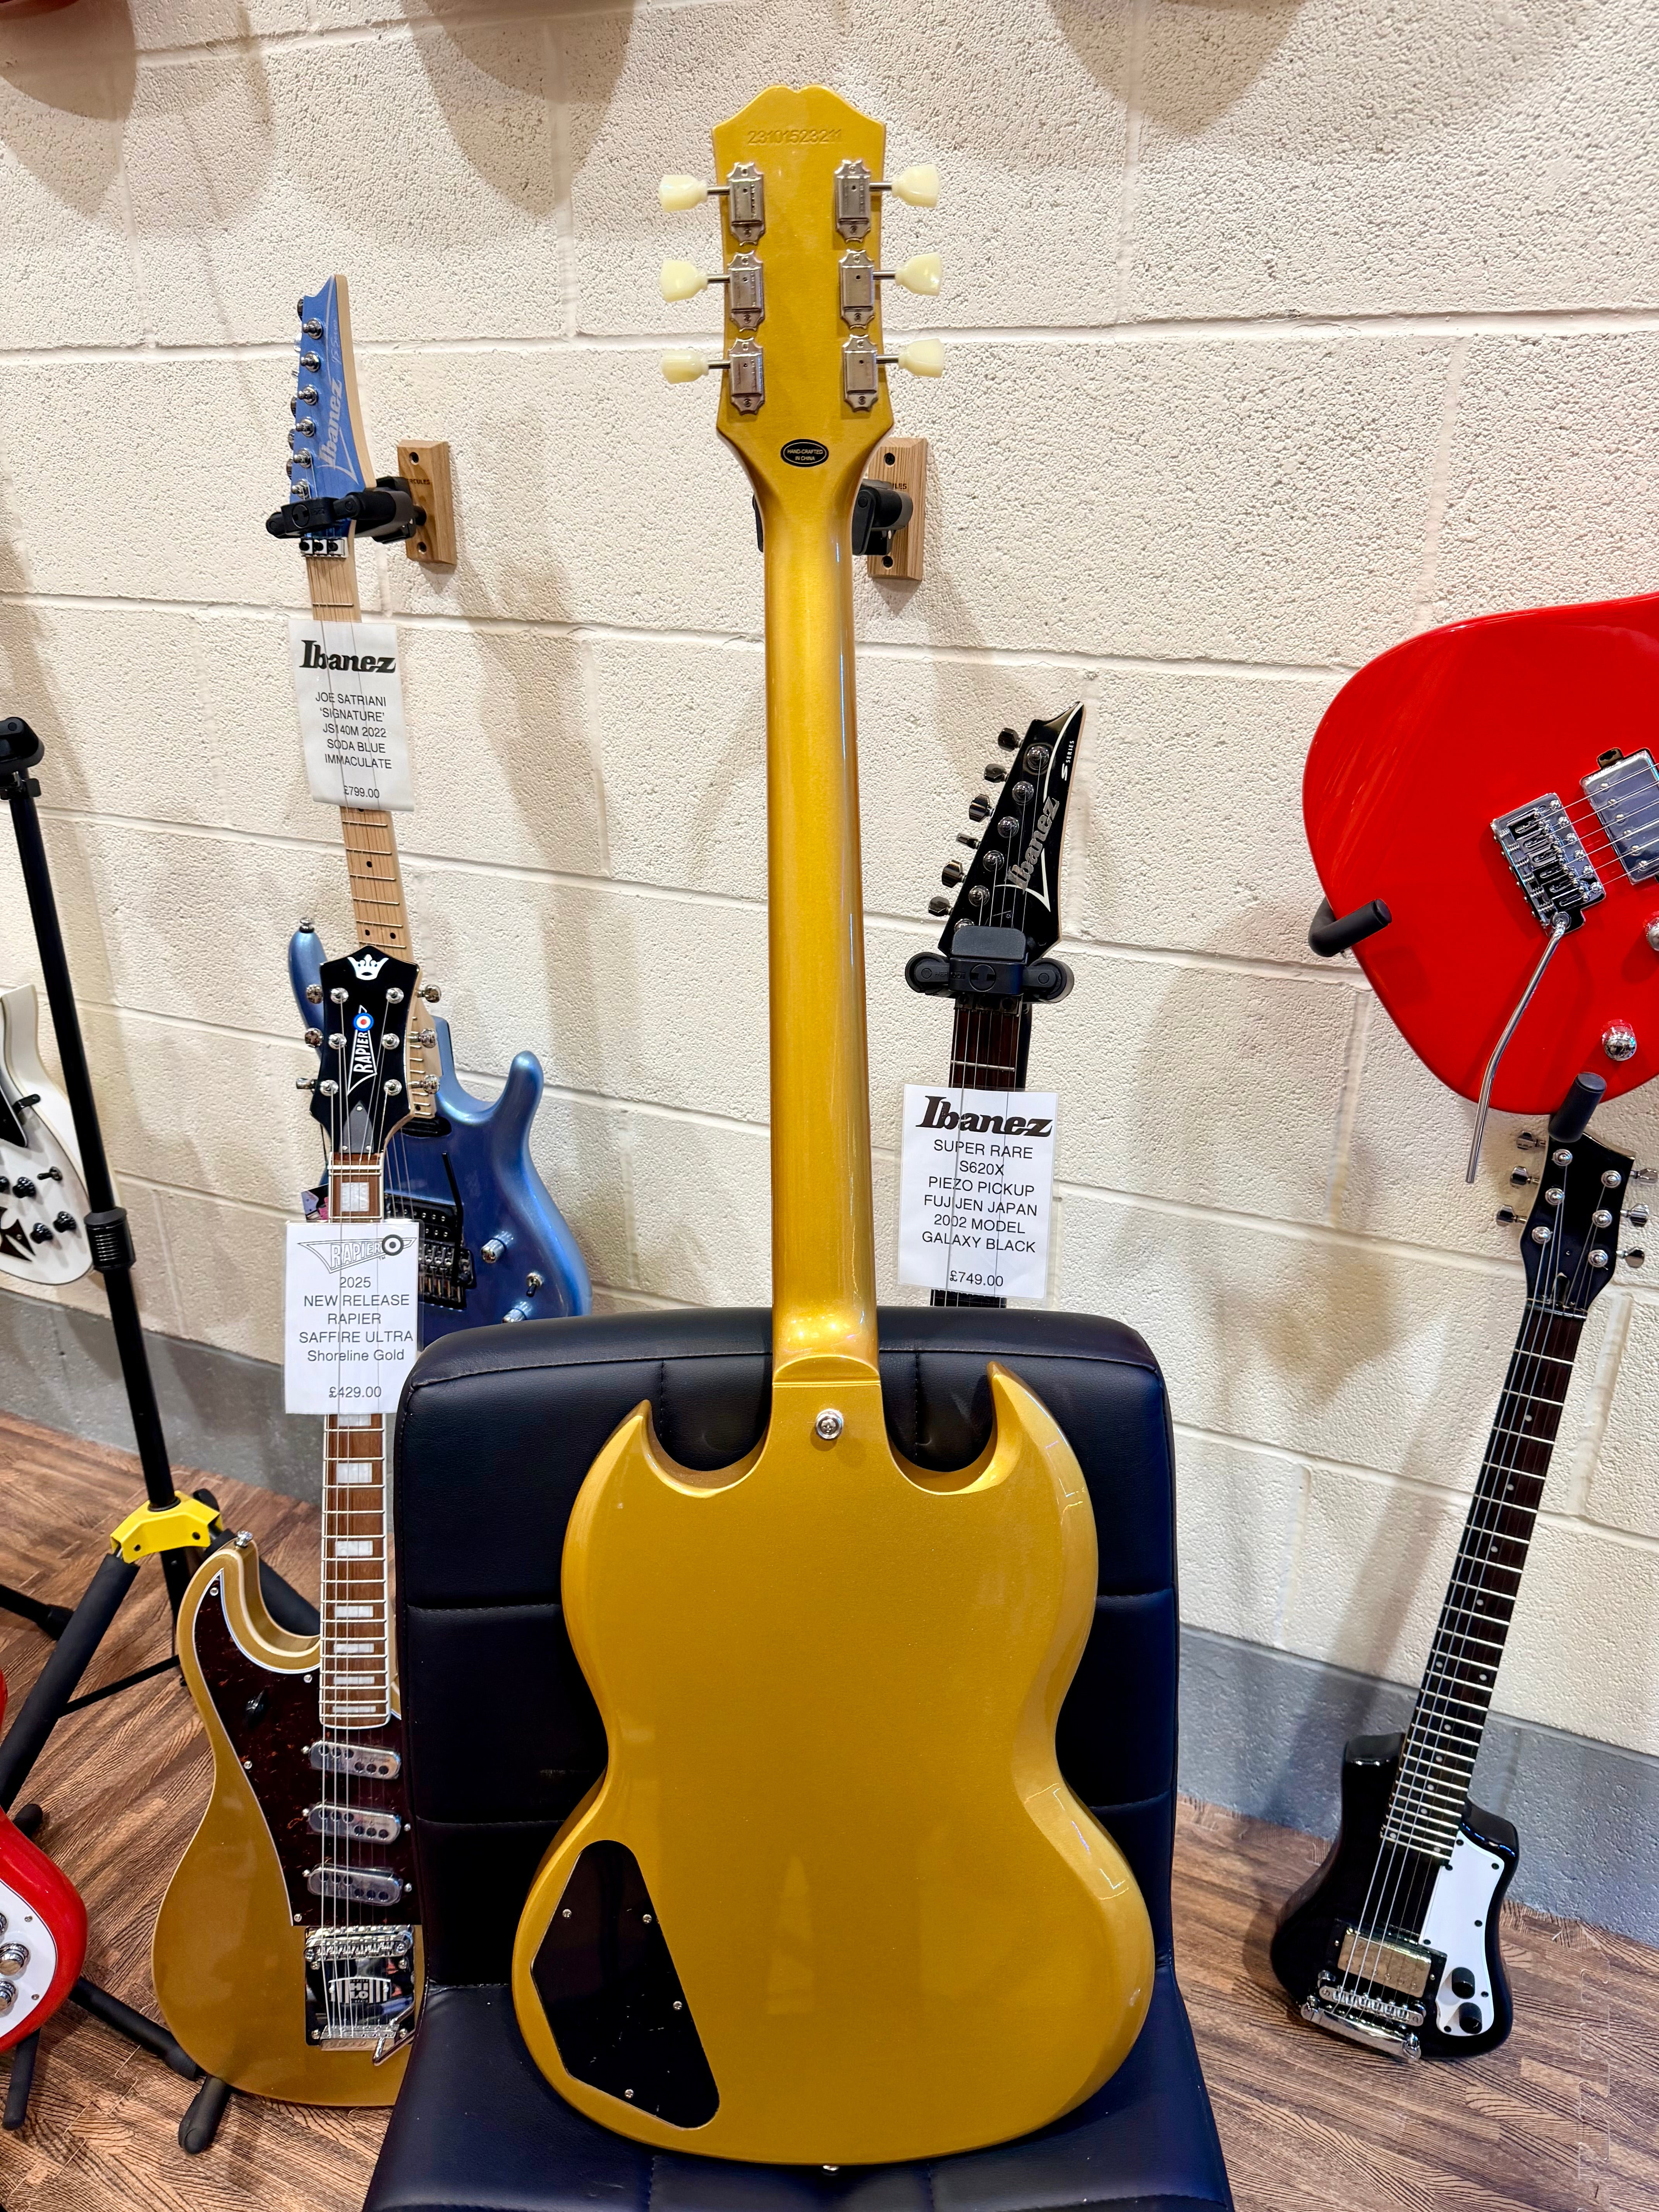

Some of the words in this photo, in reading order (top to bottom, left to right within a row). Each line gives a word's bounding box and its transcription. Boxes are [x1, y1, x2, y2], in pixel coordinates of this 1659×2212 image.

[318, 380, 343, 470] Ibanez
[299, 640, 396, 673] Ibanez
[315, 692, 335, 703] JOE
[338, 694, 386, 706] SATRIANI
[362, 727, 386, 737] 2022
[327, 739, 355, 750] SODA
[357, 742, 386, 753] BLUE
[1066, 740, 1075, 763] SERIES
[325, 754, 392, 769] IMMACULATE
[344, 785, 380, 798] £799.00
[1005, 796, 1060, 895] Ibanez
[353, 1032, 373, 1073] RAPIER
[915, 1096, 1053, 1137] Ibanez
[934, 1139, 984, 1155] SUPER
[991, 1145, 1033, 1159] RARE
[960, 1160, 1004, 1176] S620X
[929, 1176, 973, 1191] PIEZO
[978, 1182, 1034, 1197] PICKUP
[988, 1201, 1037, 1216] JAPAN
[934, 1214, 967, 1228] 2002
[972, 1218, 1025, 1234] MODEL
[922, 1231, 981, 1248] GALAXY
[986, 1238, 1036, 1253] BLACK
[331, 1242, 381, 1268] RAPIER
[340, 1277, 371, 1288] 2025
[950, 1270, 1003, 1286] £749.00
[304, 1295, 338, 1306] NEW
[343, 1294, 410, 1306] RELEASE
[328, 1313, 381, 1324] RAPIER
[299, 1331, 361, 1343] SAFFIRE
[366, 1331, 414, 1343] ULTRA
[307, 1350, 369, 1361] Shoreline
[373, 1349, 404, 1360] Gold
[329, 1386, 381, 1398] £429.00
